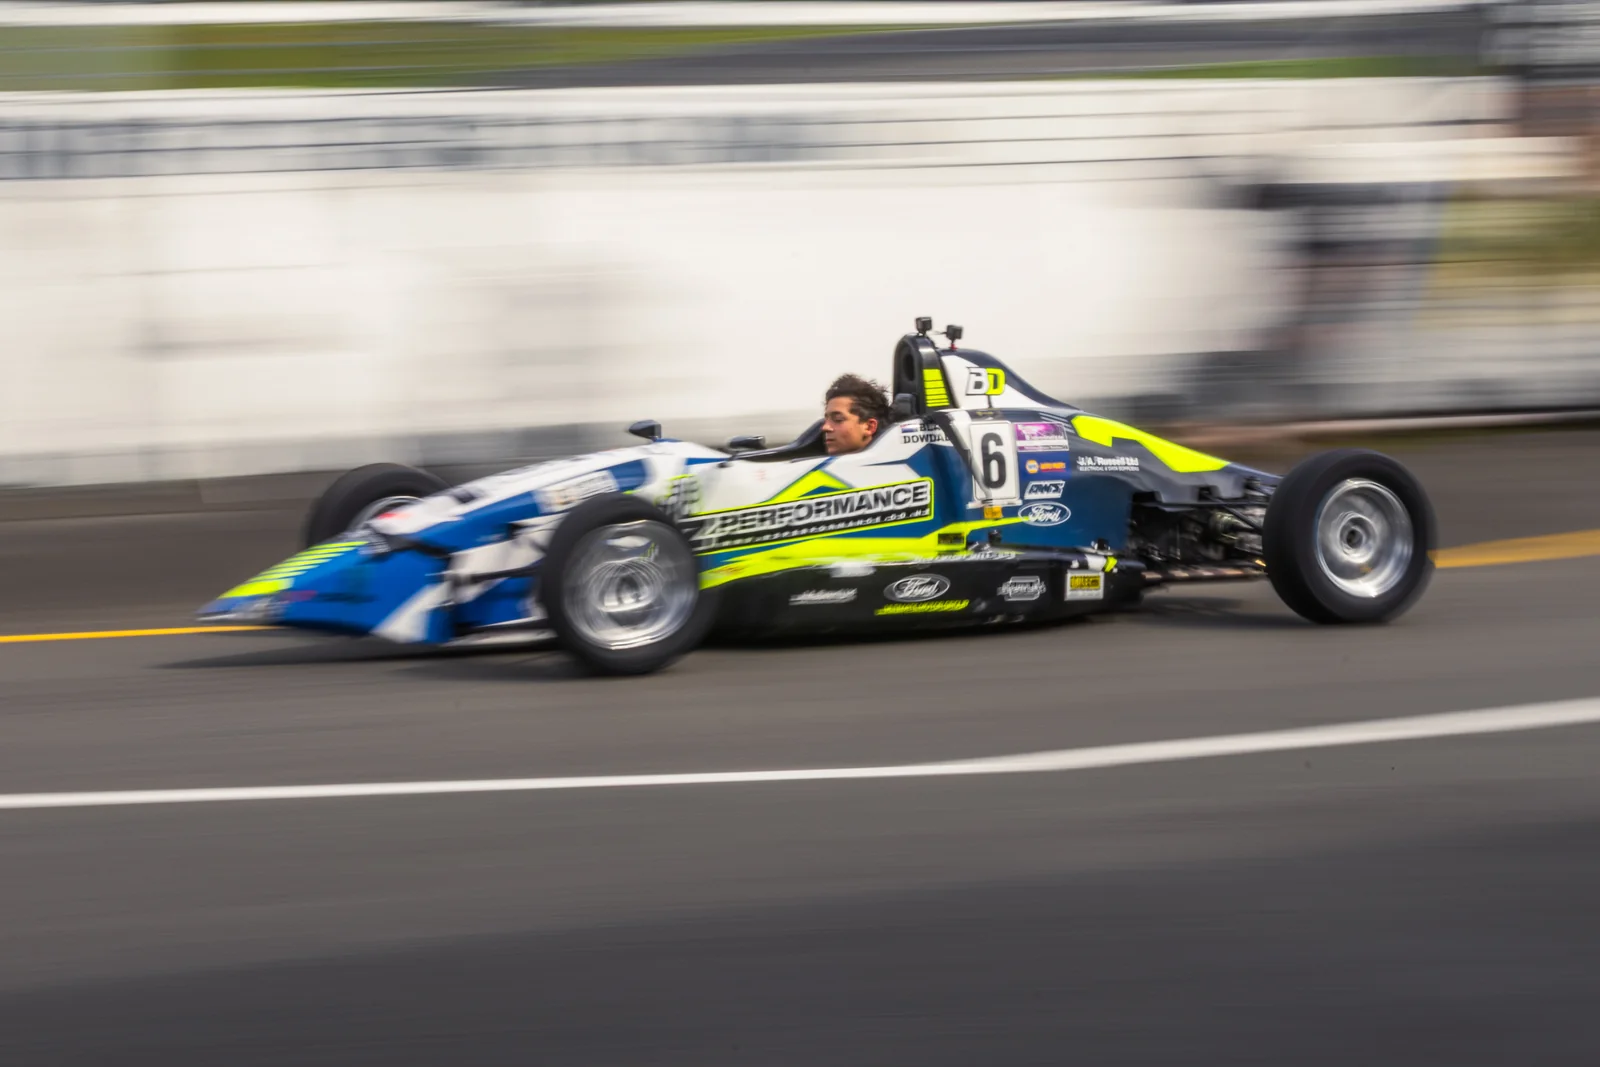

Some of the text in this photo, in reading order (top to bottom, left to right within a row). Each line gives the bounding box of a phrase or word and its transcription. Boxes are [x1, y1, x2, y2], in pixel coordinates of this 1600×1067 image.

[981, 432, 1007, 489] 6
[717, 483, 929, 532] PERFORMANCE
[1029, 505, 1061, 522] Ford
